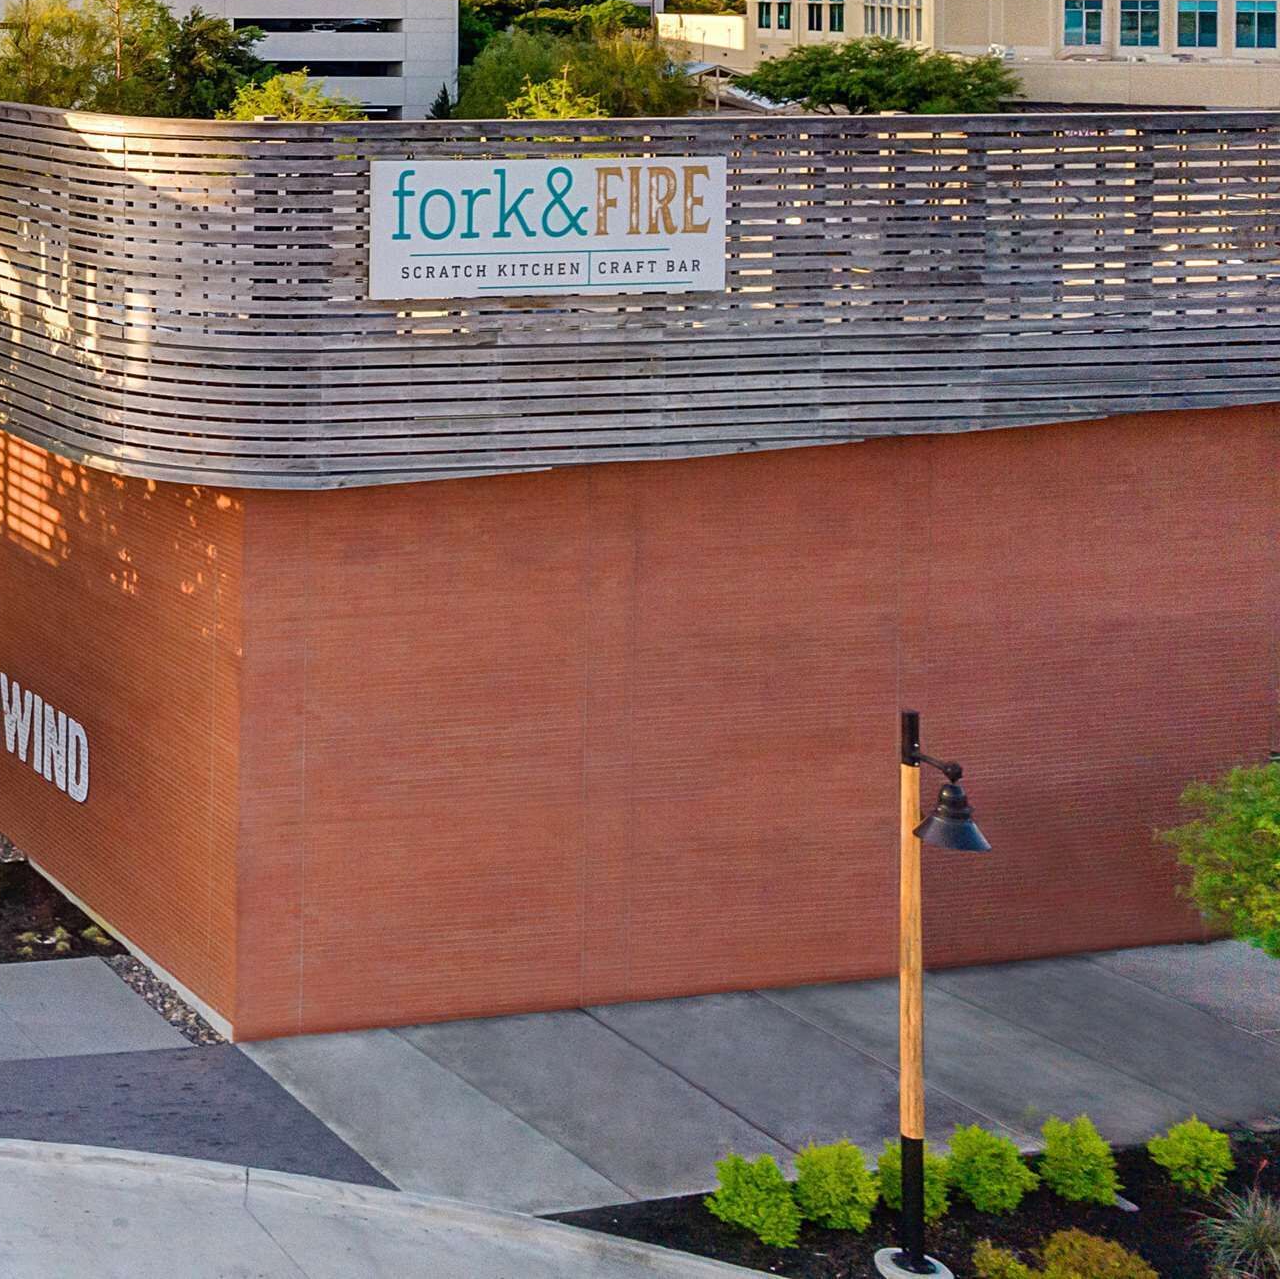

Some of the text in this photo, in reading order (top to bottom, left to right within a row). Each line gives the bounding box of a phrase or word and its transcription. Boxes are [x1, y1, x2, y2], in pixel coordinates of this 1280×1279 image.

[401, 258, 702, 280] SCRATCH KITCHEN CRAFT BAR
